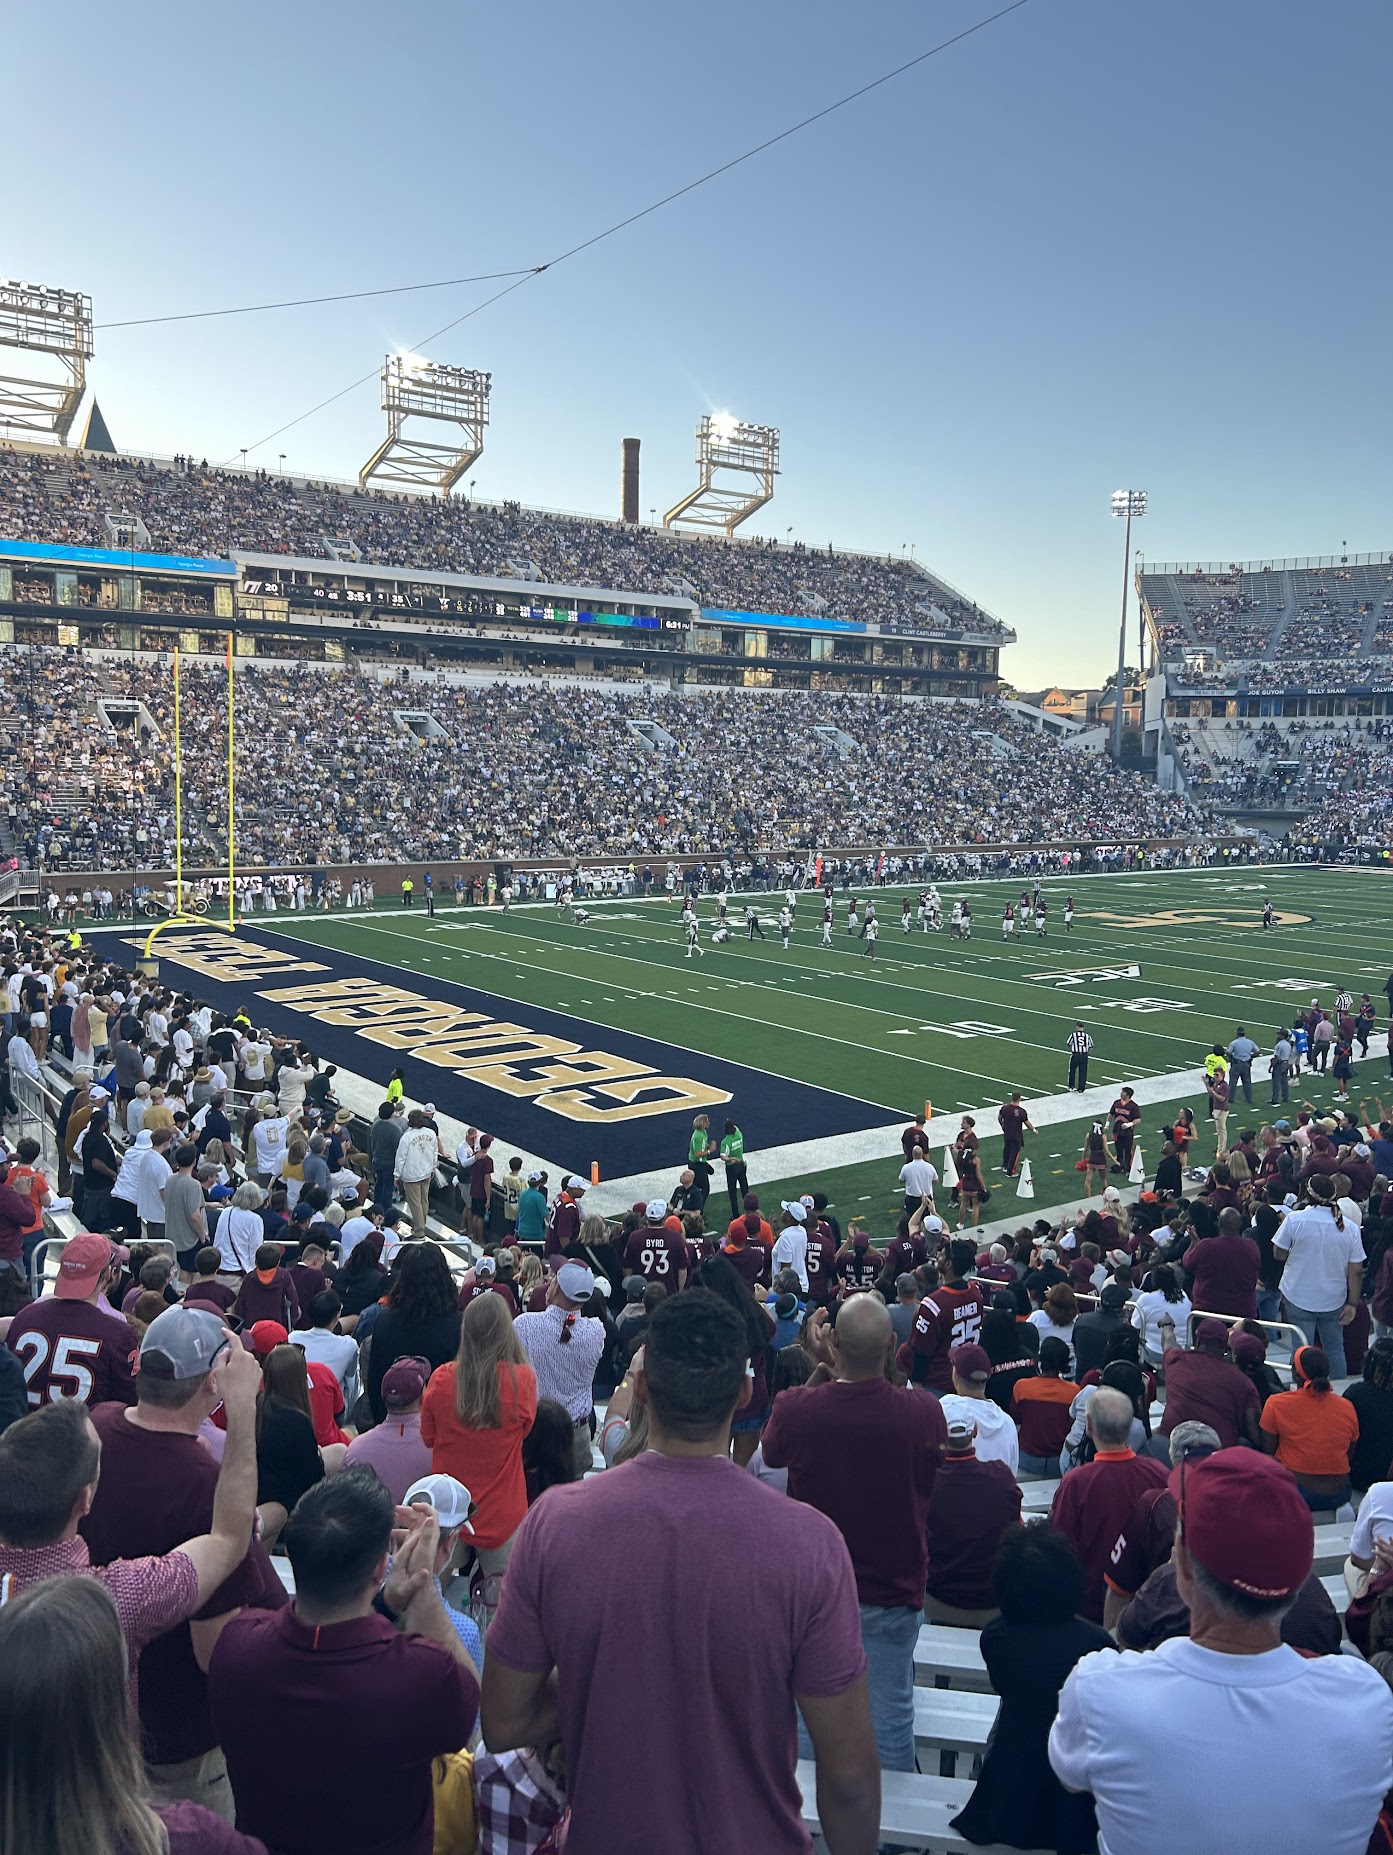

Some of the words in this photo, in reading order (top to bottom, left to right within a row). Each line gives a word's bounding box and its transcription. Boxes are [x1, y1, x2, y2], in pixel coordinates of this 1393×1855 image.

[264, 583, 278, 592] 20
[313, 589, 325, 597] 40
[346, 590, 372, 603] 3:51
[391, 594, 404, 603] 35
[916, 630, 947, 638] CASTLEBERRY
[1099, 997, 1195, 1013] 20
[919, 1019, 1018, 1039] 10
[253, 976, 735, 1123] GEORGIA
[1078, 1036, 1085, 1046] S
[645, 1238, 665, 1248] BYRD
[640, 1249, 670, 1275] 93
[953, 1302, 978, 1321] BEAMER
[915, 1314, 931, 1335] 25
[950, 1314, 983, 1348] 25
[14, 1328, 103, 1406] 25
[1110, 1533, 1127, 1565] 5
